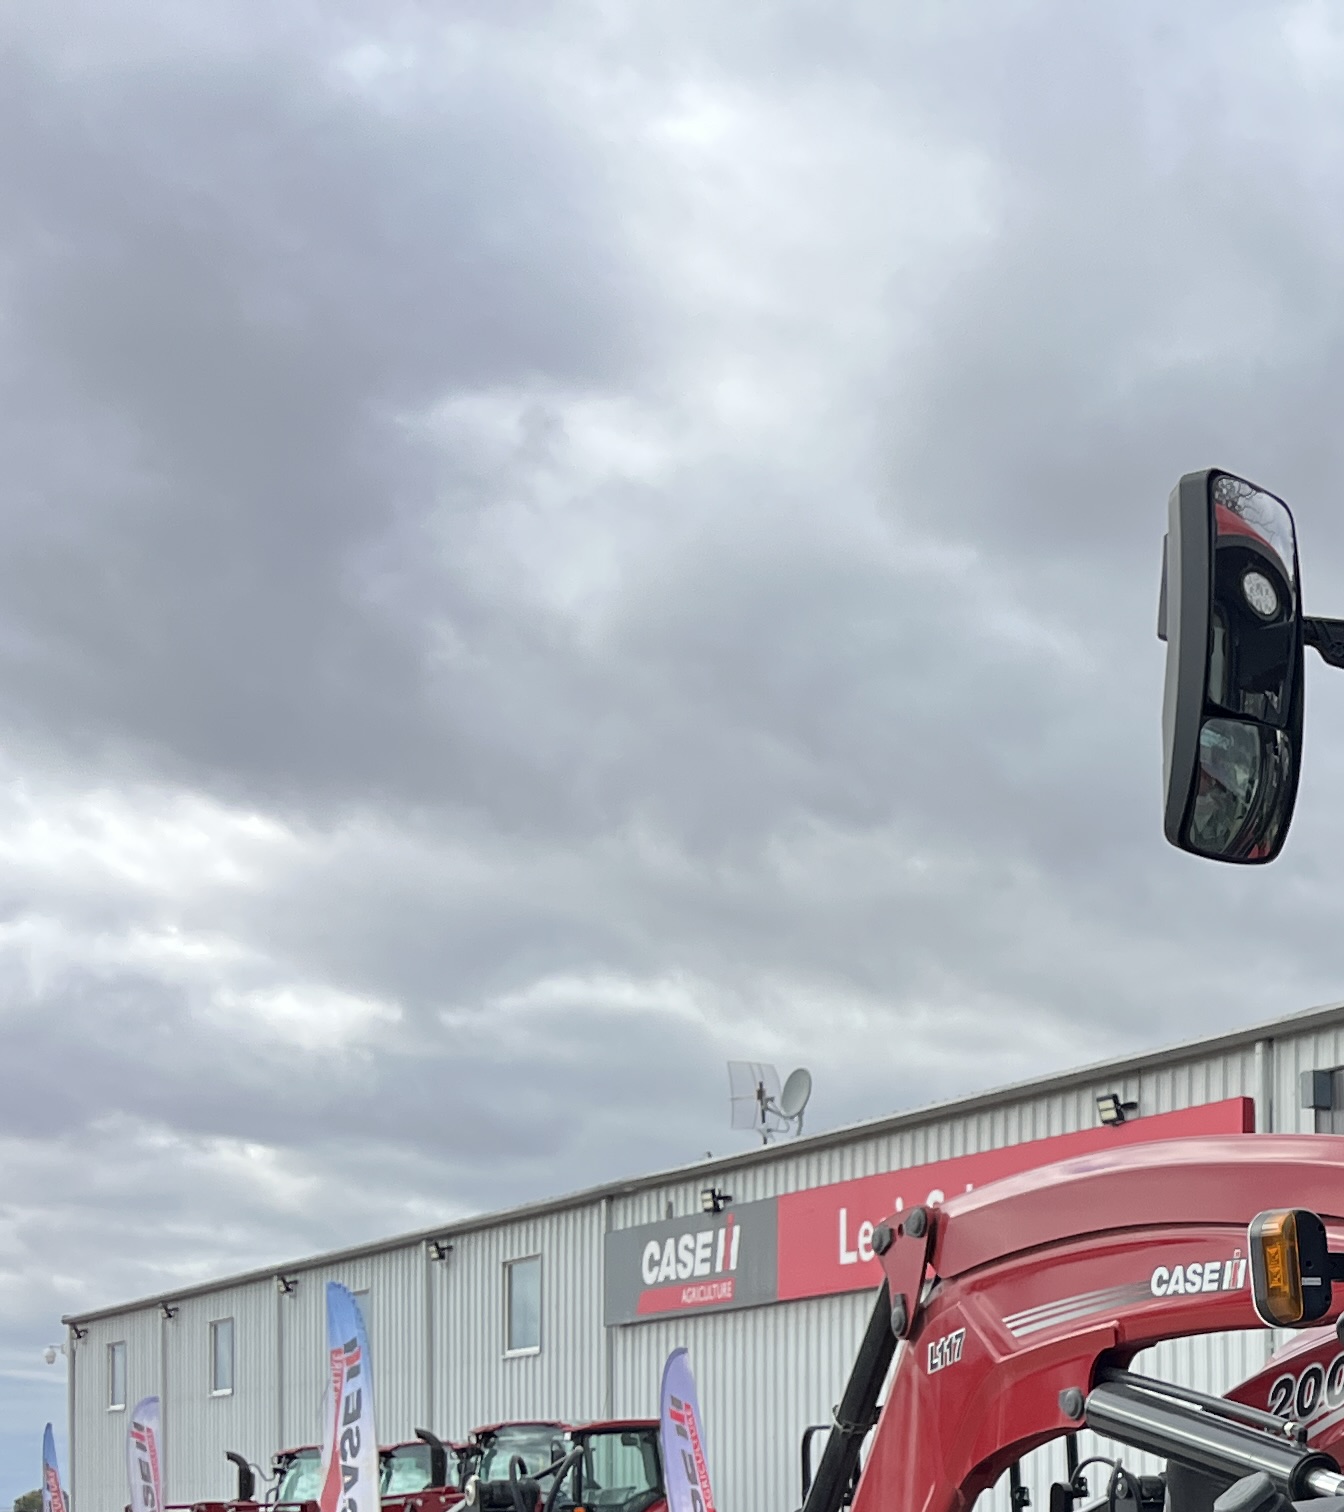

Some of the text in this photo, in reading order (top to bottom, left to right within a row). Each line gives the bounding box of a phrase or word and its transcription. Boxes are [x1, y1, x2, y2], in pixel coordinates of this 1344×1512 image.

[642, 1230, 713, 1285] CASE
[681, 1281, 732, 1303] AGRICULTURE
[1151, 1261, 1221, 1296] CASE
[927, 1327, 966, 1374] L117
